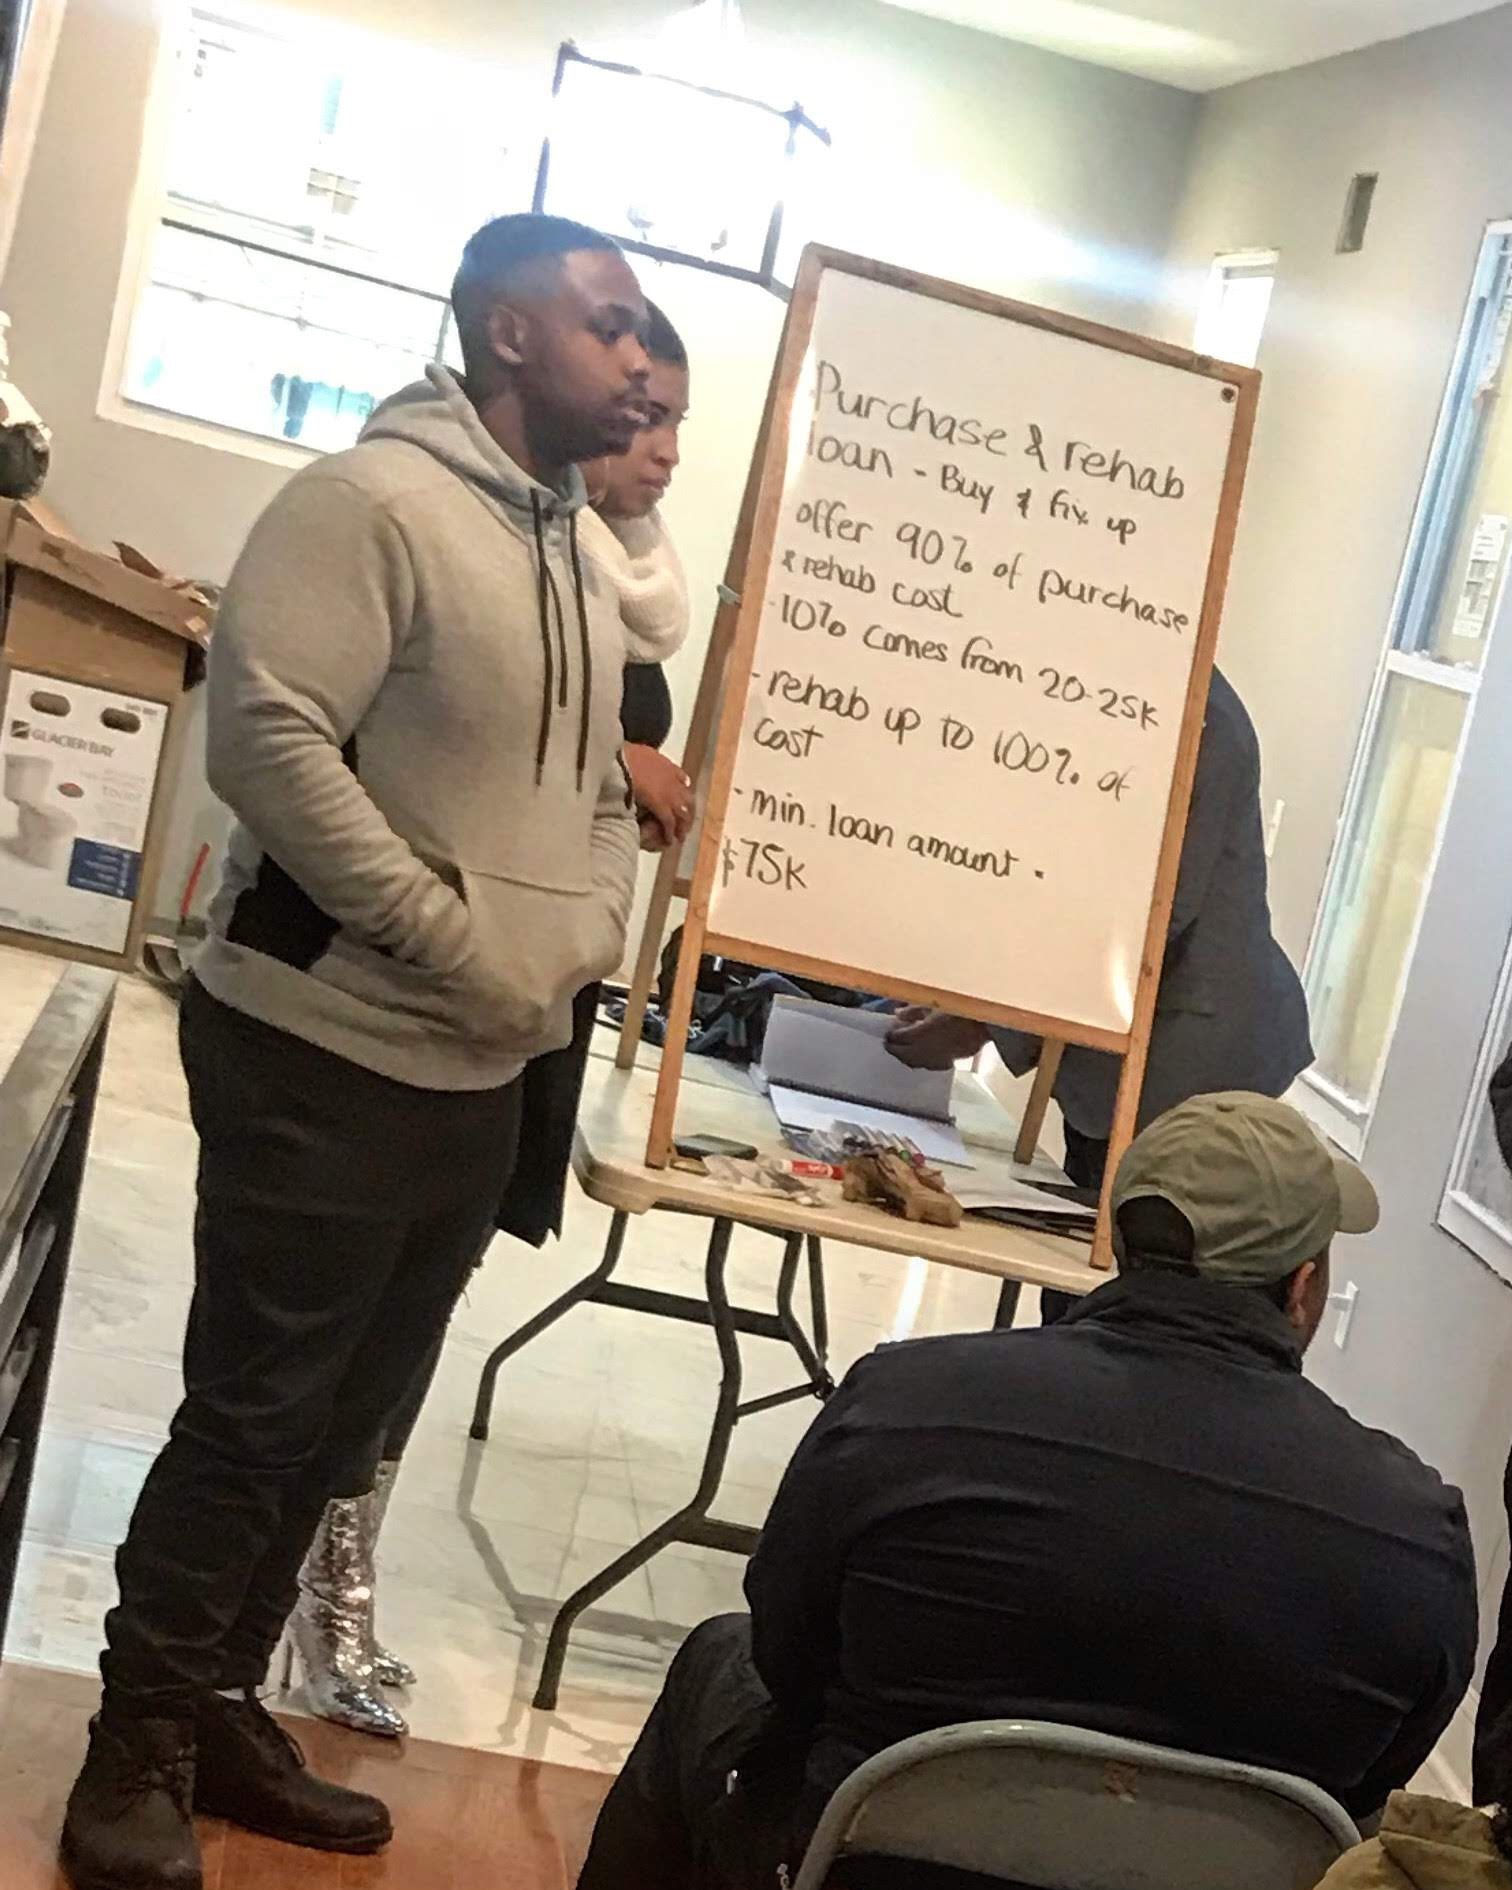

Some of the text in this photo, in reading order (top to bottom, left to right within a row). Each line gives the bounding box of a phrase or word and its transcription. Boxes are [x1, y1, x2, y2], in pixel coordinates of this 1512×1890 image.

[813, 360, 1184, 500] Purchase & rehab
[807, 419, 894, 478] loan
[940, 464, 995, 515] Buy
[1048, 488, 1090, 526] fix
[1106, 516, 1138, 545] up
[795, 500, 1189, 634] offer 90% of purchase
[803, 554, 877, 595] rehab
[891, 580, 964, 618] cost
[863, 623, 949, 664] comes
[960, 634, 1024, 684] from
[32, 727, 116, 758] GLACIER BAY
[753, 716, 824, 758] cost
[884, 705, 921, 745] up
[940, 713, 975, 751] to
[992, 729, 1081, 786] 100%
[1096, 764, 1135, 802] of
[827, 803, 895, 848] loan
